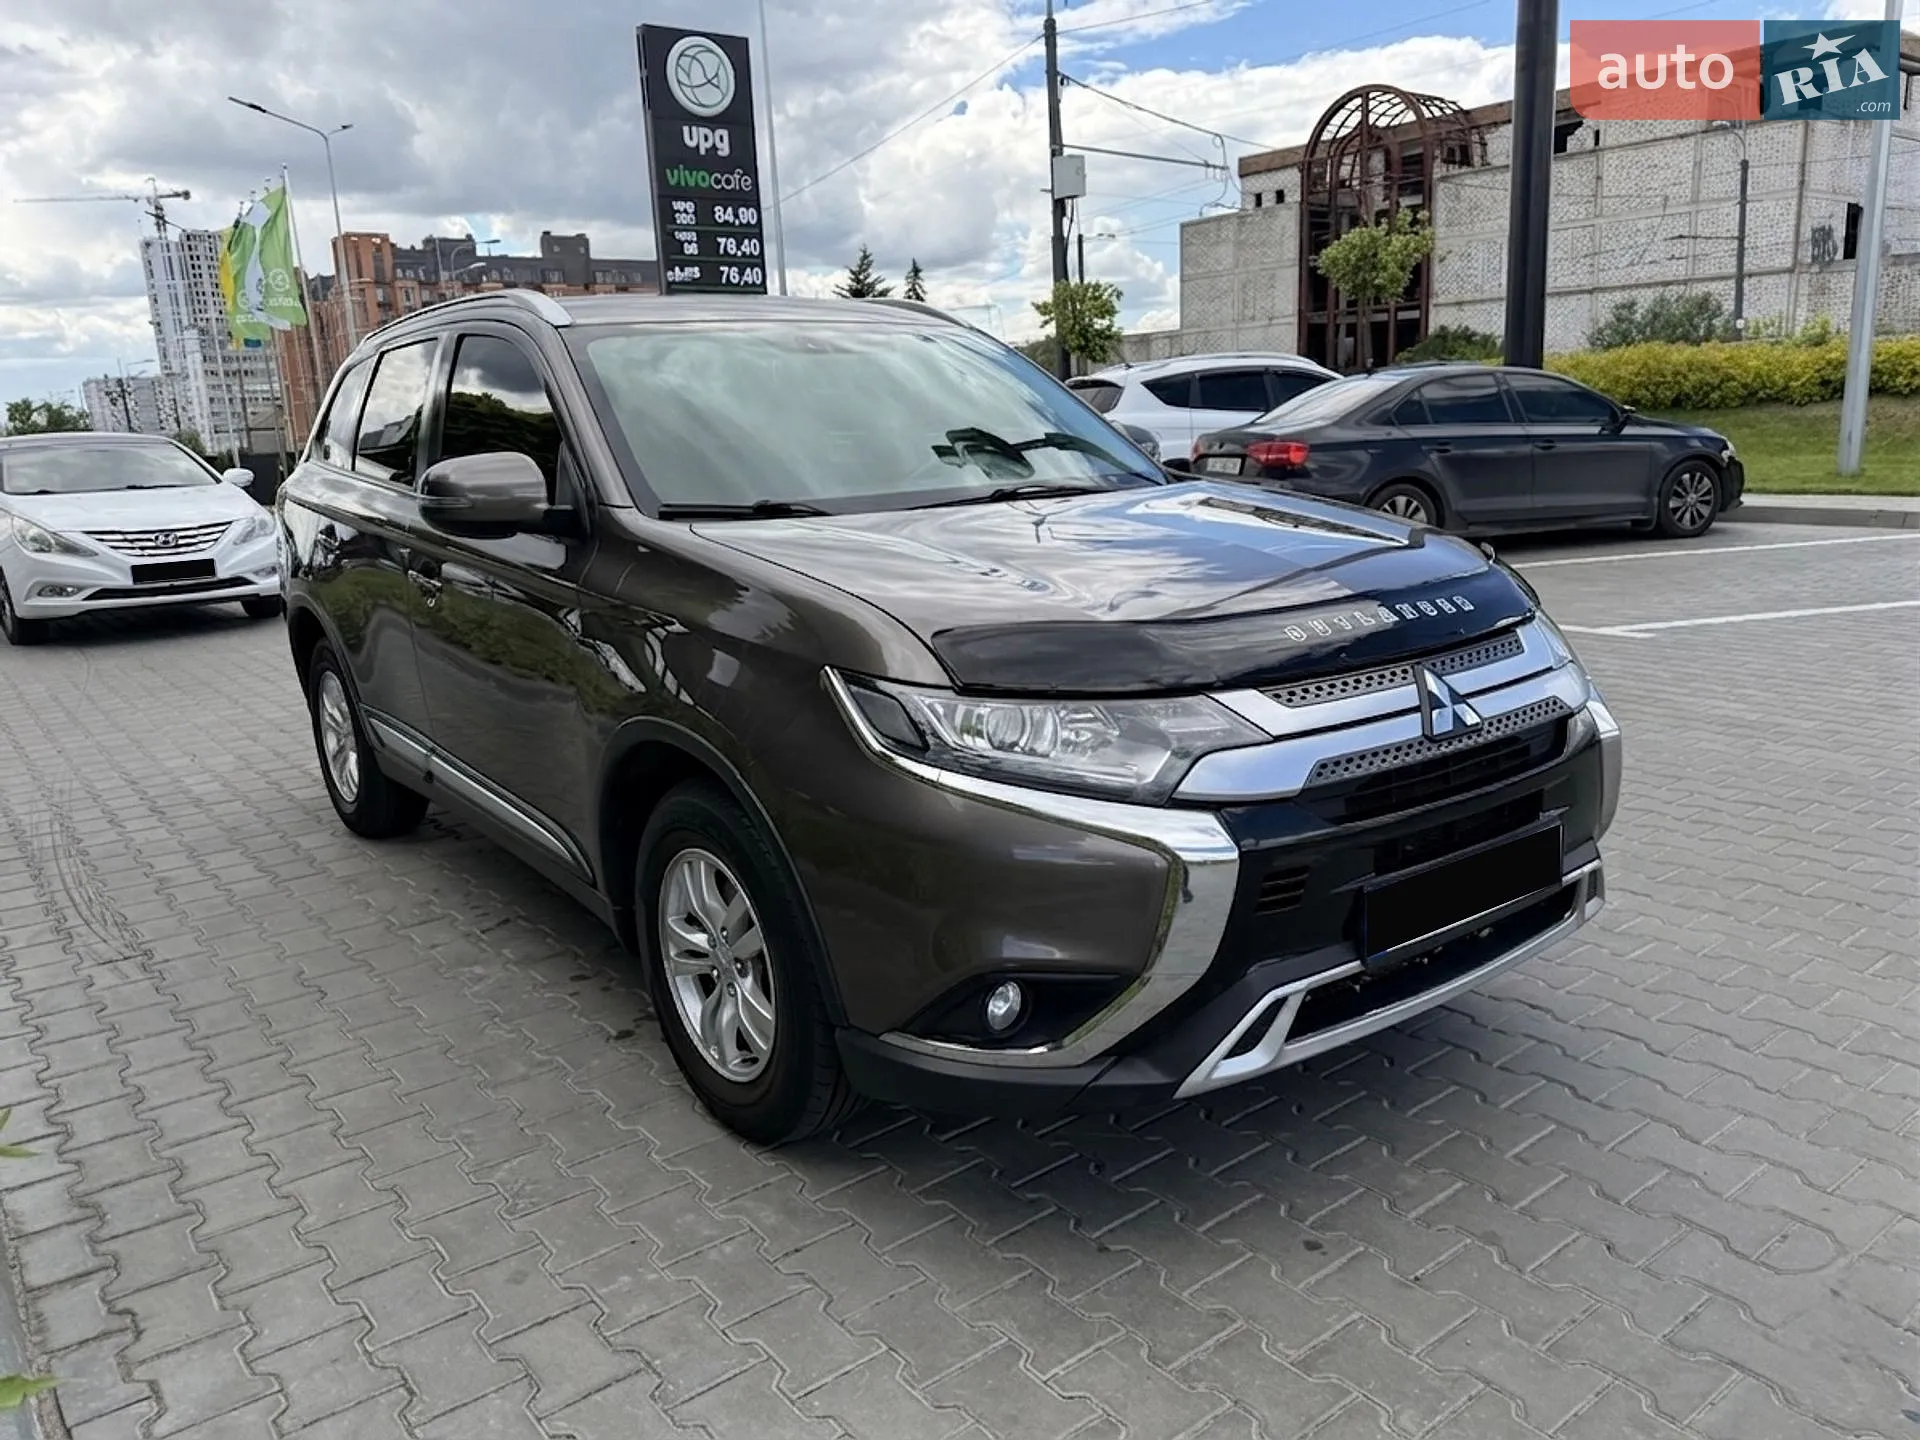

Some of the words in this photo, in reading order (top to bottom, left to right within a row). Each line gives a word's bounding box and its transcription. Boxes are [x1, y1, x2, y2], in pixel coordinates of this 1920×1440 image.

[682, 125, 730, 157] upg
[665, 163, 752, 191] vivocafe
[719, 265, 763, 286] 76,40
